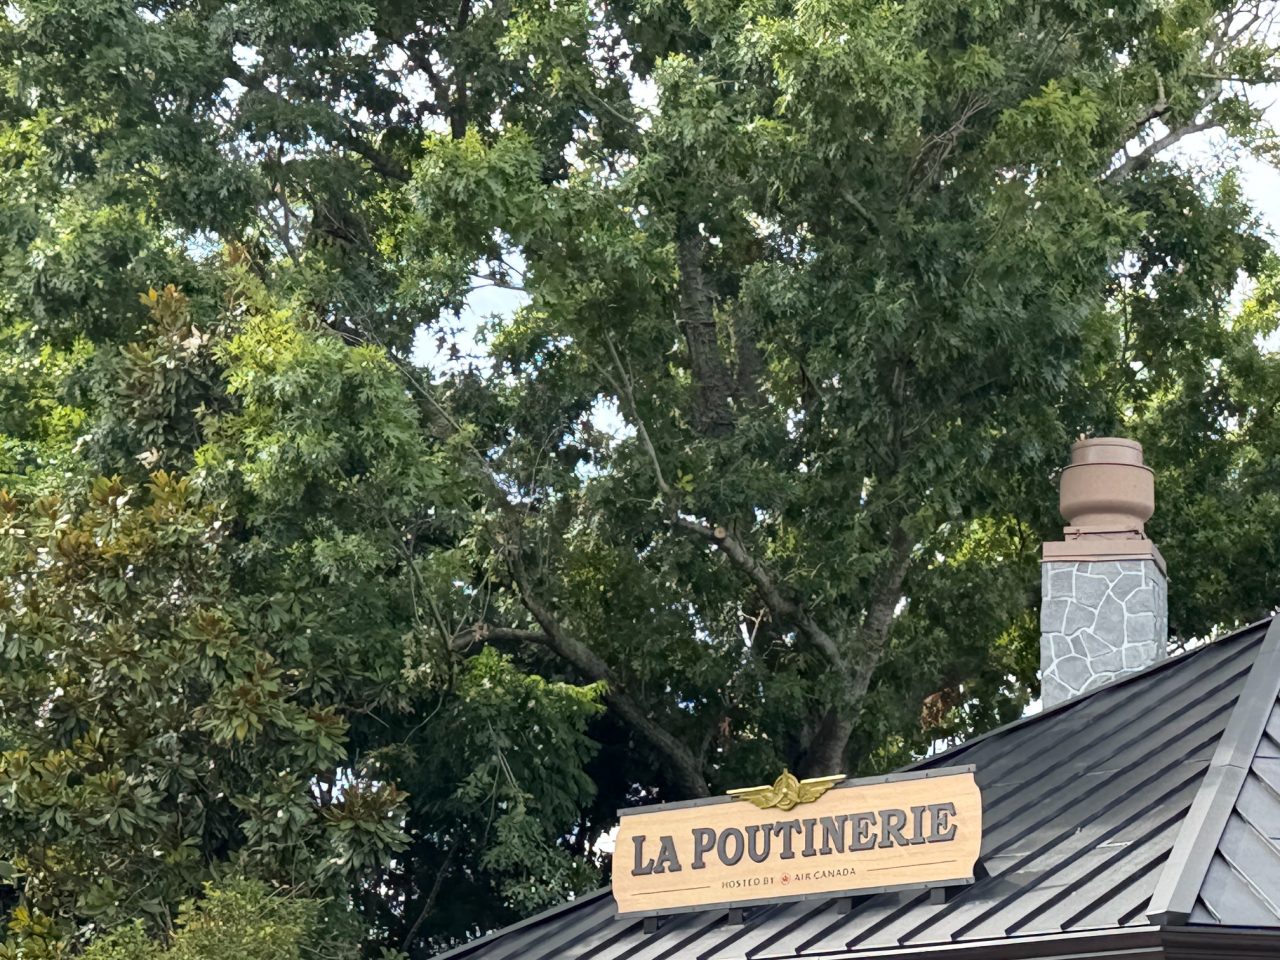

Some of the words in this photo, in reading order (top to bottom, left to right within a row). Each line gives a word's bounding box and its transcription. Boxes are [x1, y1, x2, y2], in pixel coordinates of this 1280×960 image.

[631, 834, 682, 876] LA
[691, 801, 957, 870] POUTINERIE
[721, 877, 761, 889] HOSTED
[794, 872, 812, 882] AIR
[813, 867, 857, 880] CANADA
